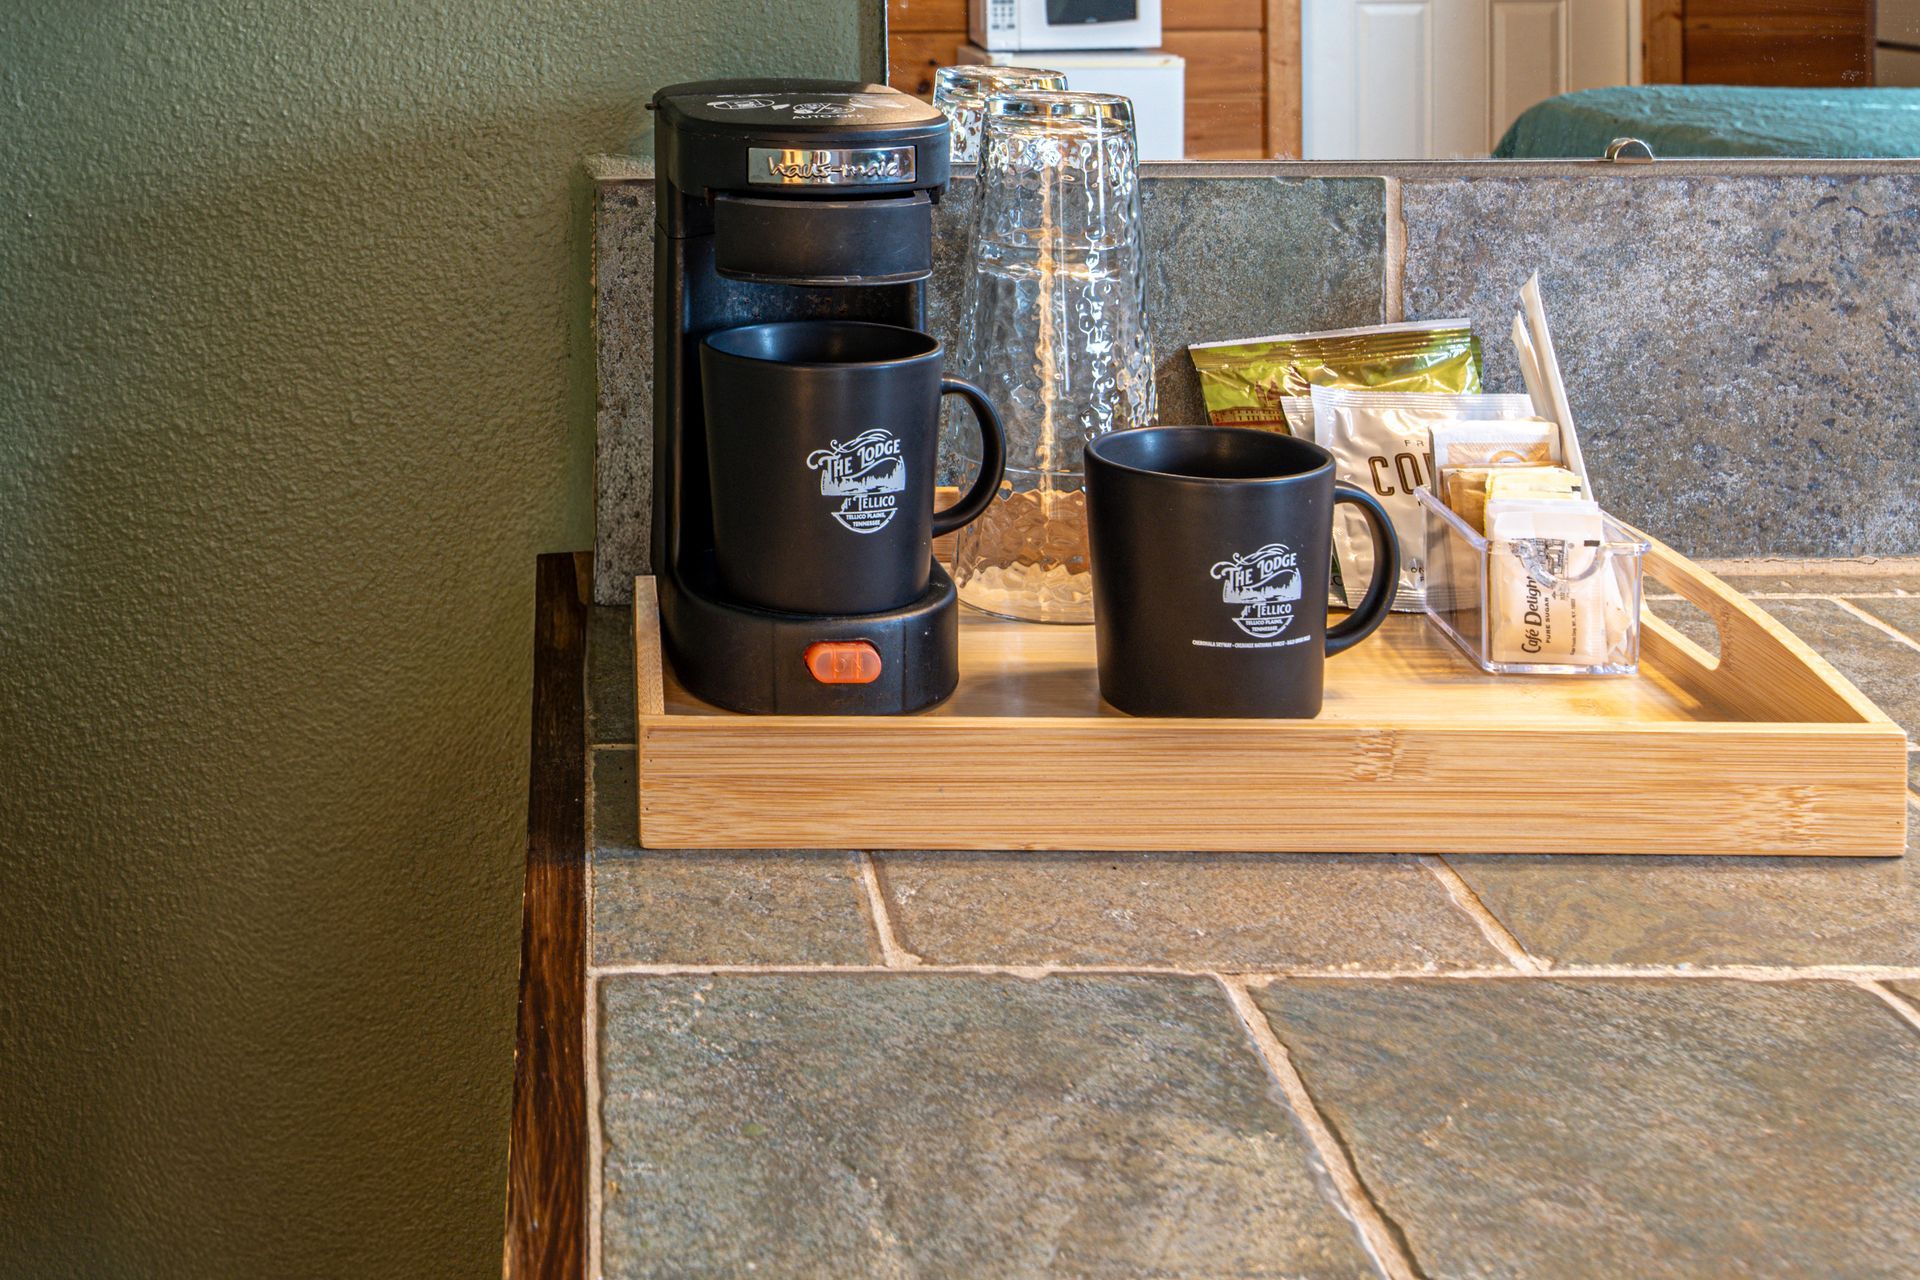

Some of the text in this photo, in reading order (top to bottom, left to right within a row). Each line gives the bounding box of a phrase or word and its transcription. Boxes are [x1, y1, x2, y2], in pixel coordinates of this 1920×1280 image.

[768, 153, 900, 179] haus-maid
[857, 439, 901, 469] LODGE
[841, 494, 895, 512] AT TELLICO
[1257, 552, 1297, 578] LODGE
[1253, 603, 1292, 617] TELLICO
[1521, 630, 1542, 654] Café
